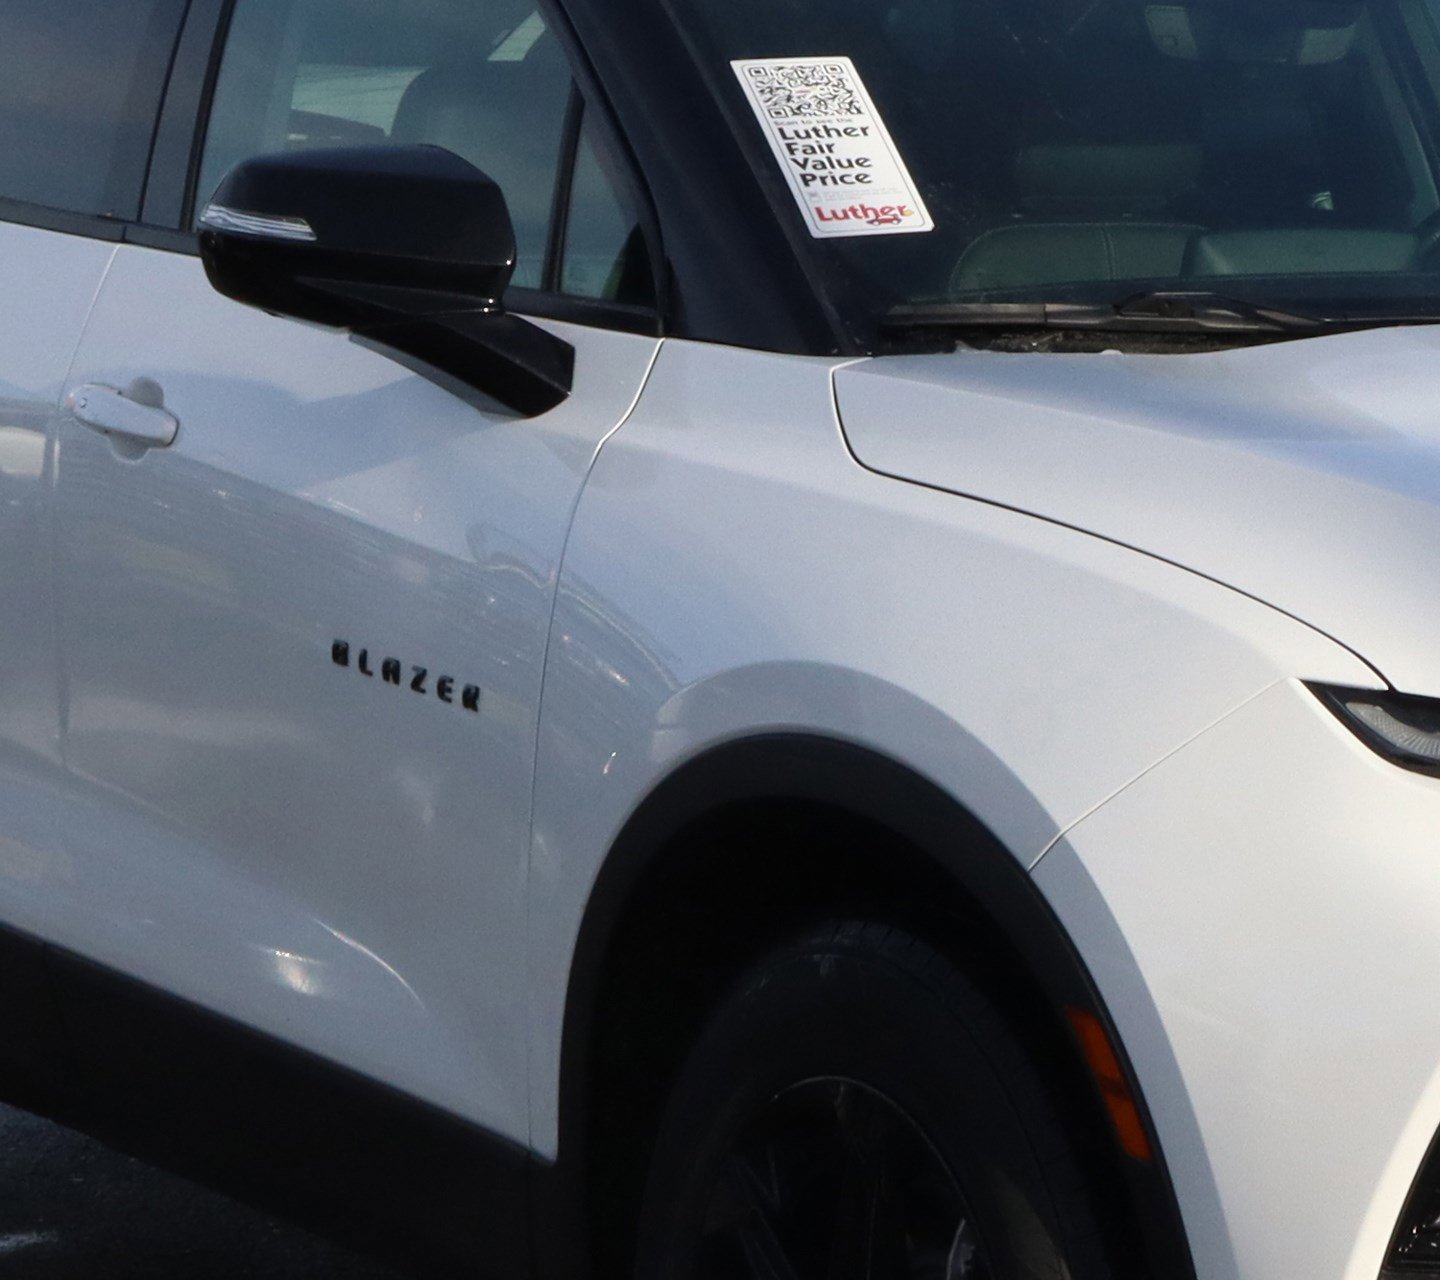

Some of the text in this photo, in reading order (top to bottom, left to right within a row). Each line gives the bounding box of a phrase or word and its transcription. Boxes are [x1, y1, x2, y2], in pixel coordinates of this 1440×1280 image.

[778, 124, 871, 141] Luther
[785, 140, 835, 156] Fair
[791, 155, 873, 172] Value
[798, 171, 873, 188] Price
[815, 203, 909, 223] Luther
[330, 638, 481, 713] BLAZER
